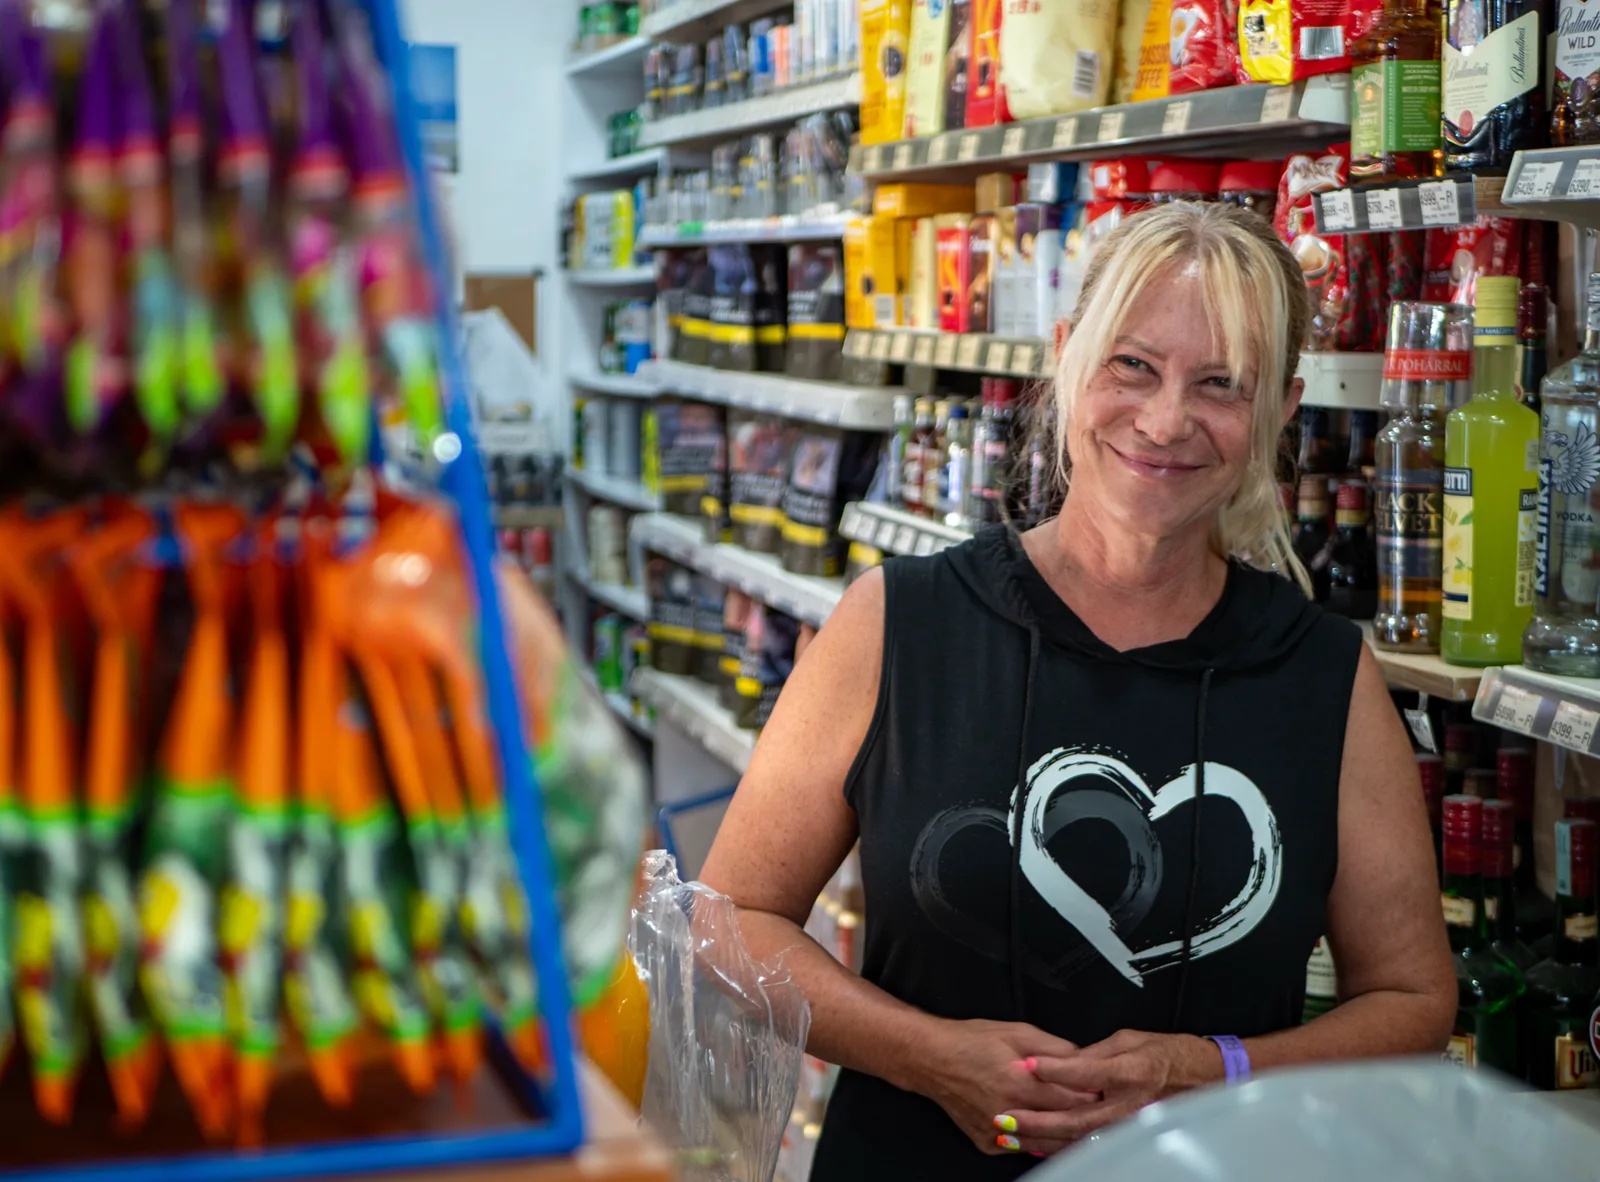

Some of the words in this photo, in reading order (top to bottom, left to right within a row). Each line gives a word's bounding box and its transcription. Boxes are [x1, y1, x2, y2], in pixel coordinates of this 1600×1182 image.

[1568, 36, 1596, 49] WILD
[1376, 490, 1436, 513] LACK
[1377, 511, 1439, 532] ELVET
[1556, 511, 1593, 522] VODKA
